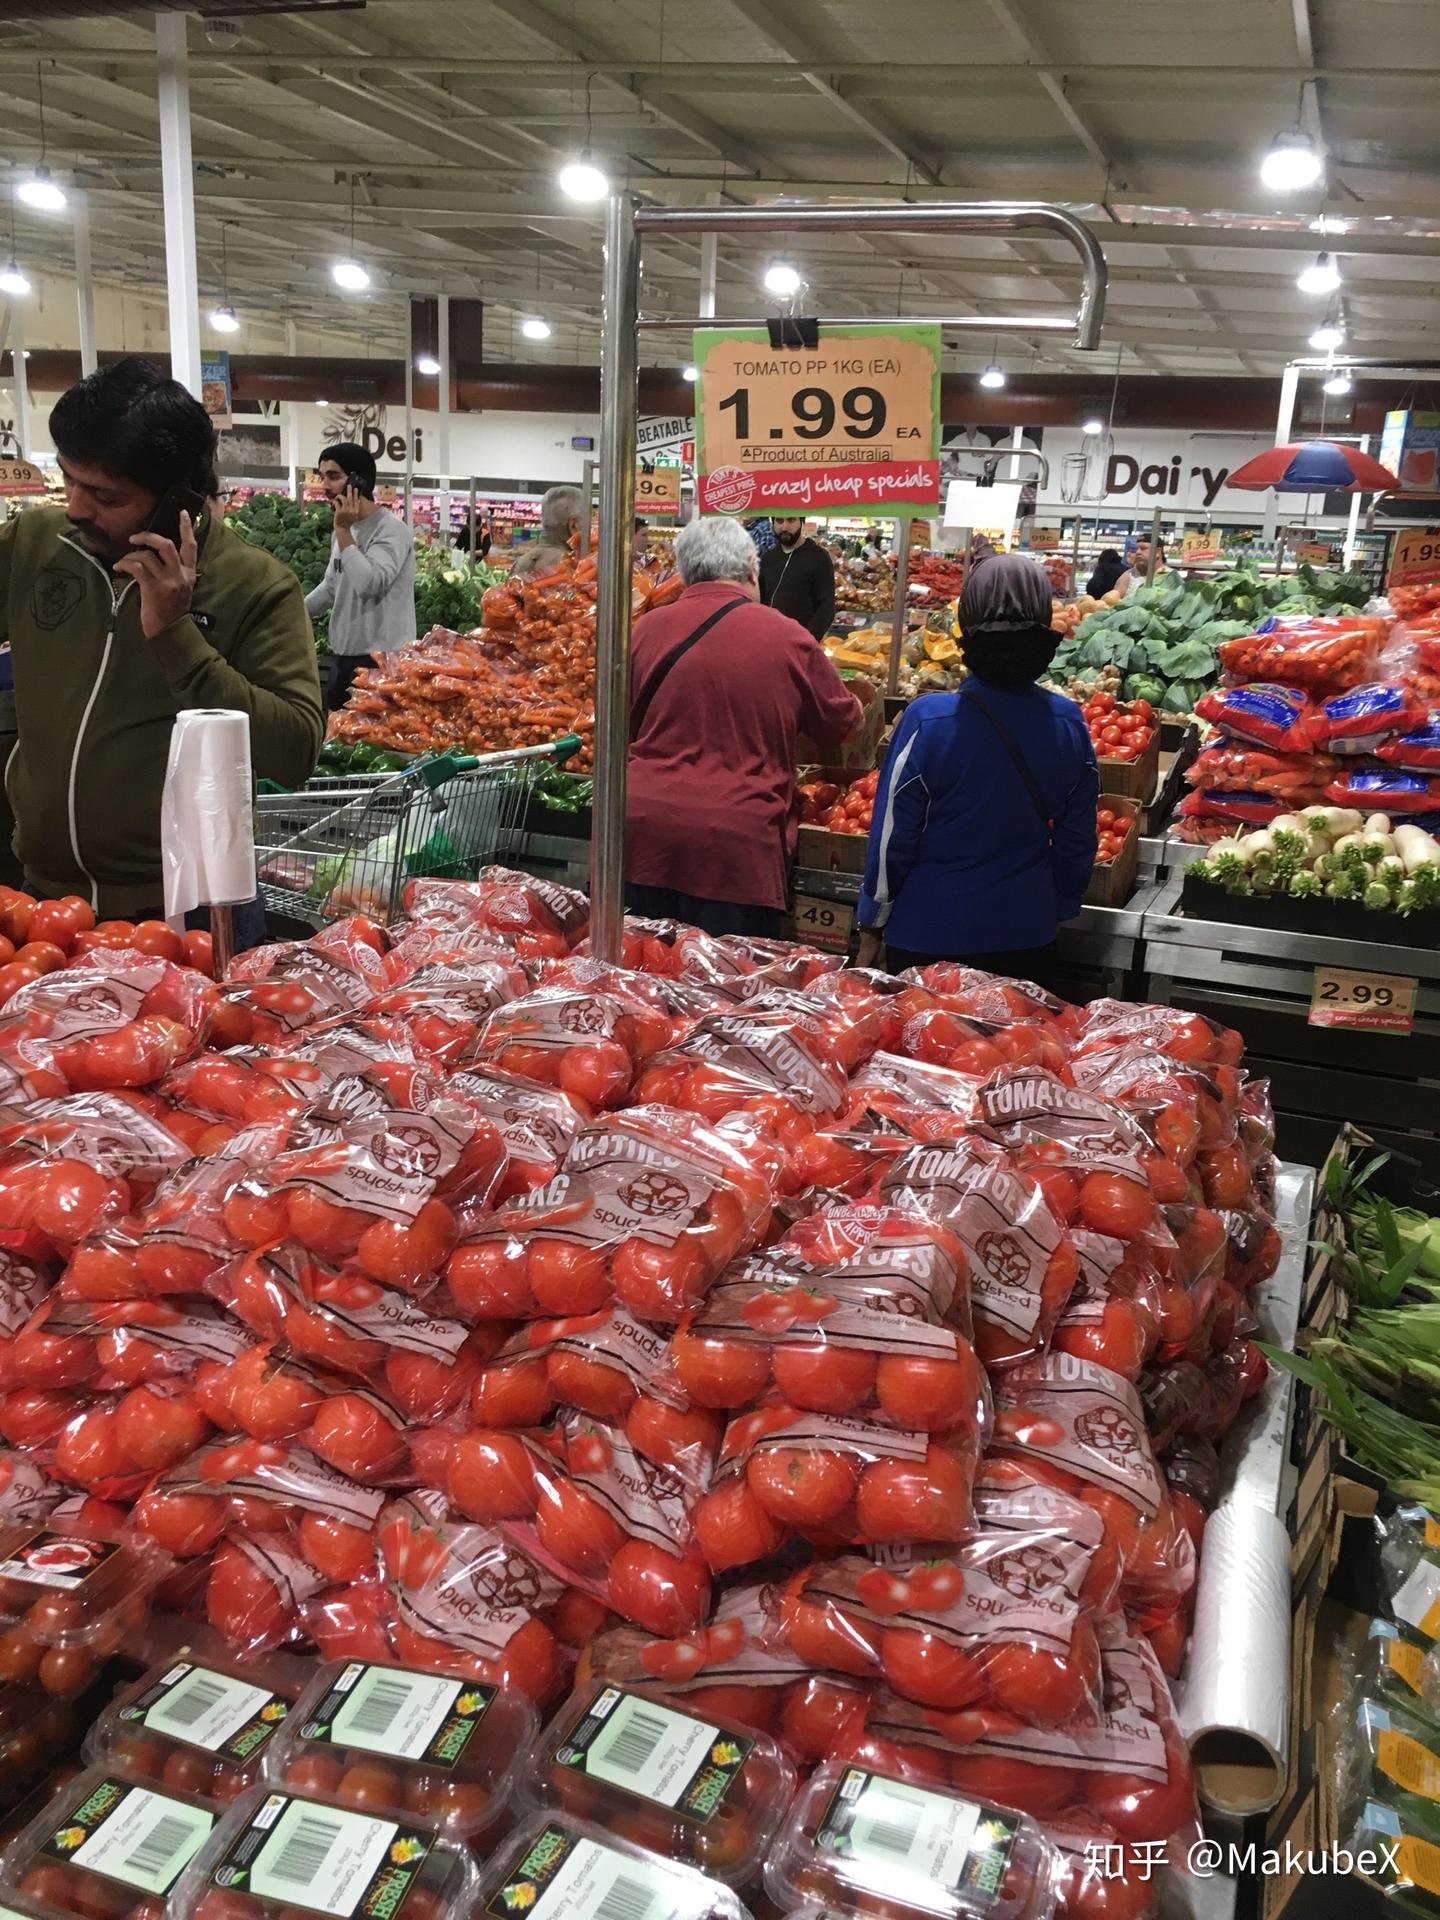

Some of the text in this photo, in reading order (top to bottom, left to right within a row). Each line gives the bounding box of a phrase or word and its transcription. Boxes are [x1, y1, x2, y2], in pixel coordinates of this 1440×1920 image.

[734, 360, 900, 376] TOMATO PP 1KG (EA)
[637, 416, 693, 444] BEATABLE
[720, 387, 921, 440] 1.99 EA
[362, 426, 422, 463] Dei
[752, 448, 890, 462] Product of Australia
[636, 480, 668, 496] 9c
[761, 466, 934, 503] crazy cheap specials
[1320, 982, 1393, 1006] 2.99
[984, 1079, 1109, 1120] TOMATOES
[434, 1580, 517, 1624] puded
[966, 1594, 1064, 1616] spued
[436, 1718, 475, 1759] FRESH
[675, 1723, 706, 1757] Cherry
[72, 1783, 119, 1823] FRESH
[690, 1768, 730, 1813] FRESH
[352, 1821, 382, 1859] Cherry
[518, 1831, 564, 1878] FRESH
[976, 1847, 1004, 1894] FRESH
[372, 1868, 411, 1919] FRESH
